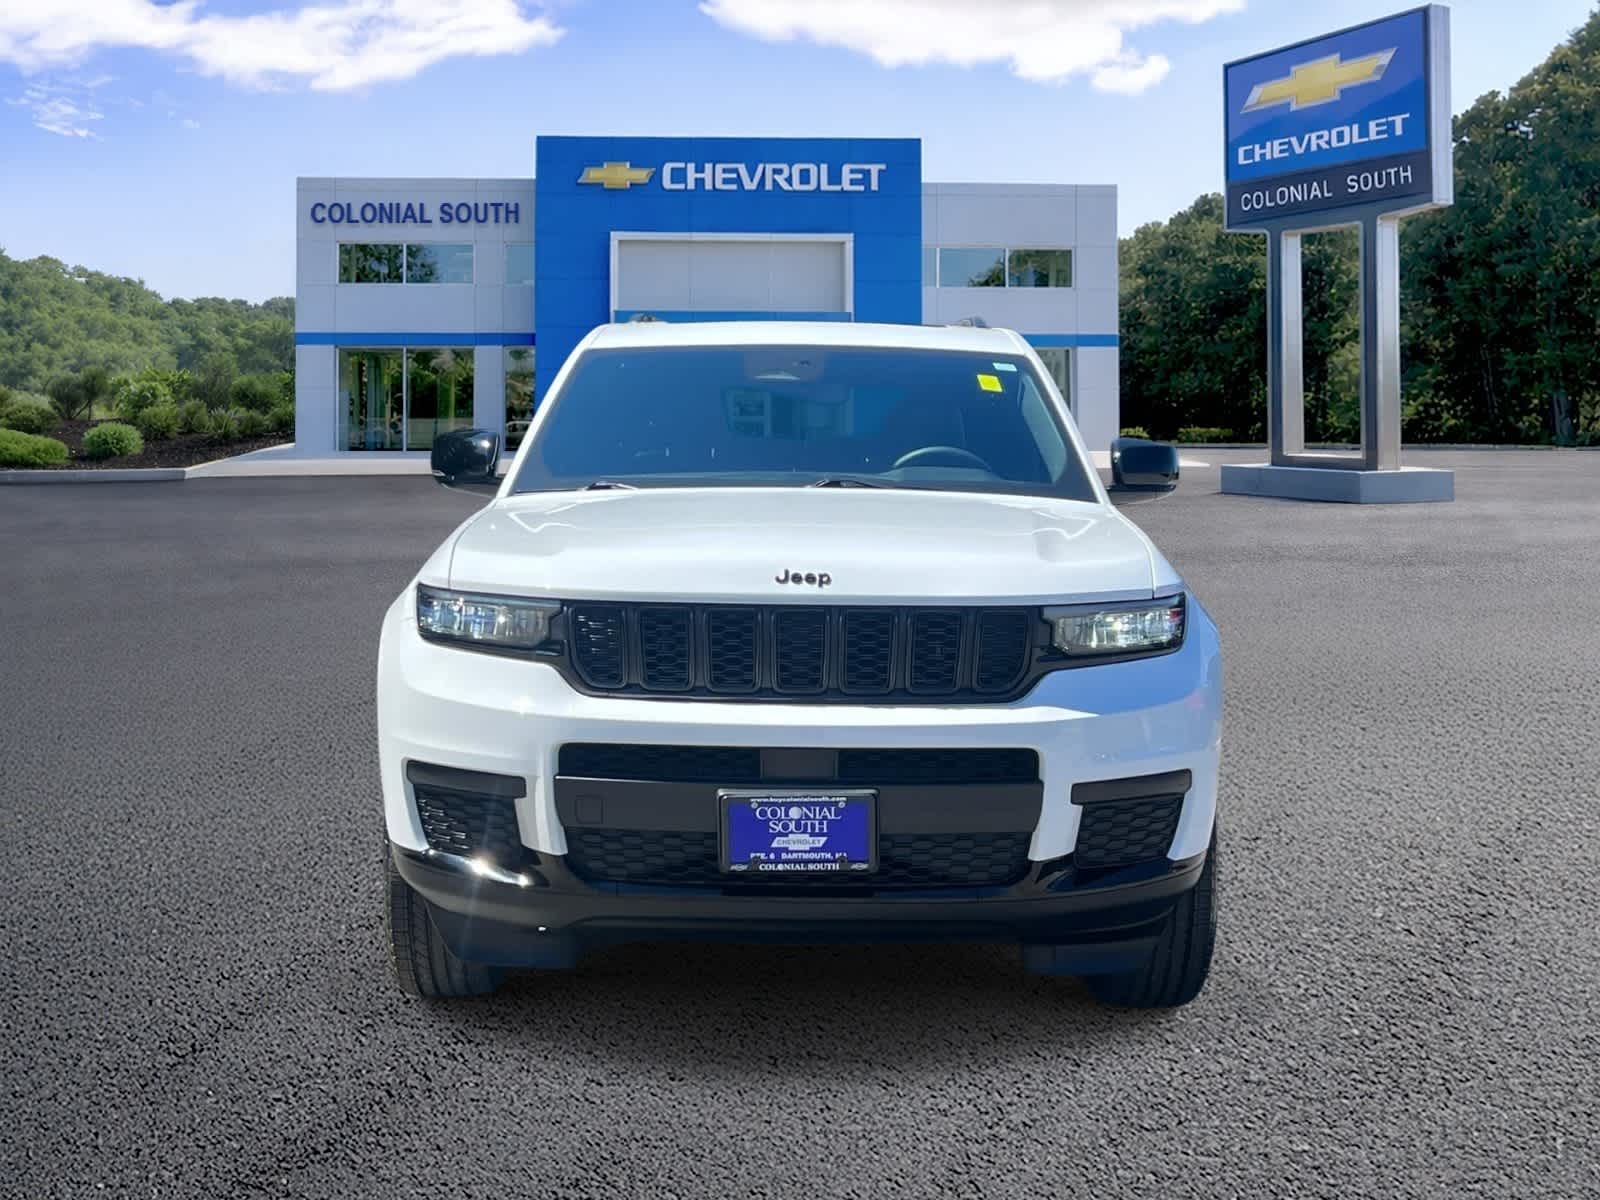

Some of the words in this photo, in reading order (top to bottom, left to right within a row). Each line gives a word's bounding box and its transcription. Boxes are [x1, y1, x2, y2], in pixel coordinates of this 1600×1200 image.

[1237, 112, 1410, 165] CHEVROLET
[661, 161, 887, 193] CHEVROLET
[1240, 179, 1333, 212] COLONIAL
[1346, 165, 1412, 193] SOUTH
[310, 201, 432, 225] COLONIAL
[439, 201, 520, 225] SOUTH
[774, 568, 833, 588] Jeep
[755, 806, 842, 820] COLONIAL
[768, 820, 828, 833] SOUTH
